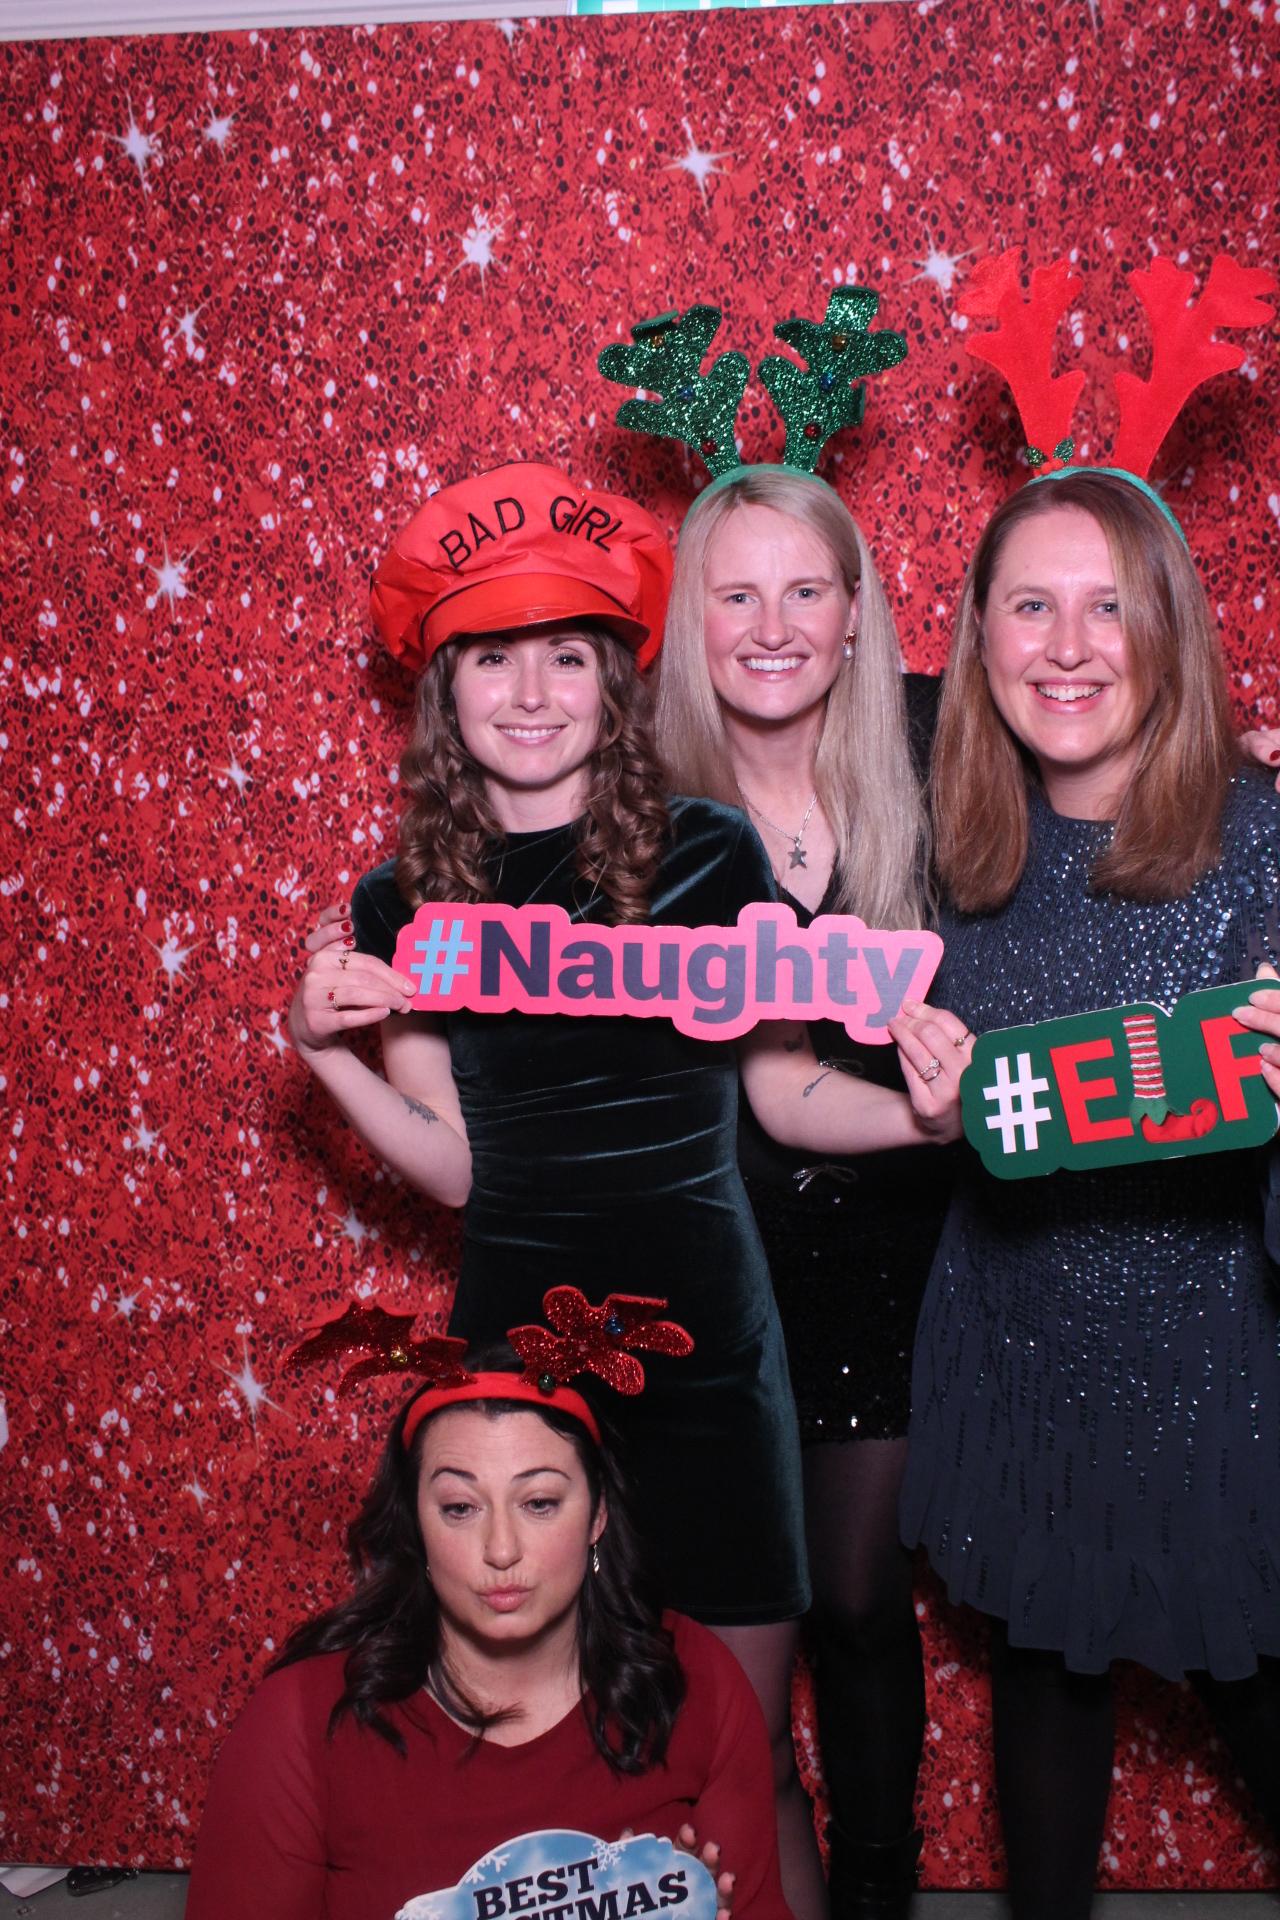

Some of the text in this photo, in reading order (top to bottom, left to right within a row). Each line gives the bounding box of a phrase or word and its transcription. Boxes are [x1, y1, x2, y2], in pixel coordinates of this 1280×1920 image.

[439, 496, 623, 569] BAD GIRL
[410, 919, 923, 1028] #Naughty
[473, 1857, 599, 1920] BEST
